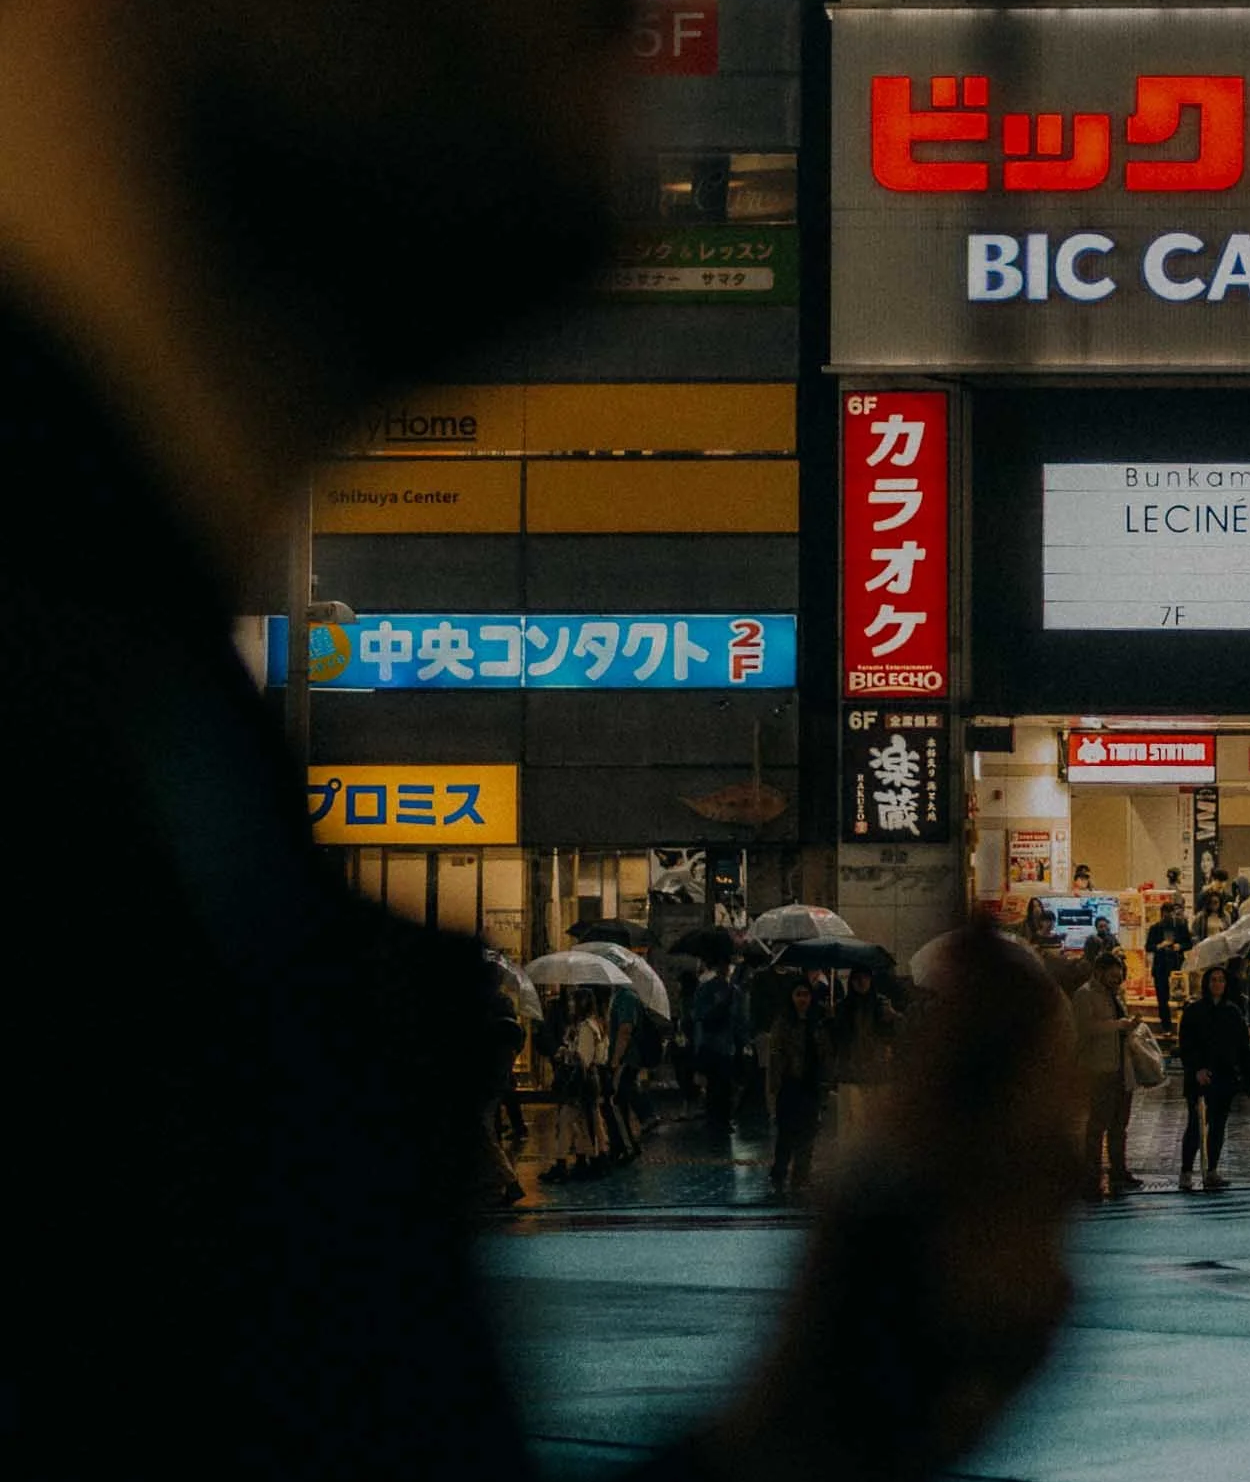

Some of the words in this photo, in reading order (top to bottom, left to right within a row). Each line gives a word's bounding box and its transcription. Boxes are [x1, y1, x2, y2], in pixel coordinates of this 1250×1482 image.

[966, 231, 1116, 302] BIC
[846, 396, 878, 416] 6F
[403, 490, 461, 505] Center
[864, 414, 927, 659] カラオケ
[1160, 606, 1186, 627] 7F
[359, 621, 709, 682] 中央コンタクト
[727, 618, 767, 683] 2F
[849, 672, 886, 691] BIG
[888, 670, 943, 691] ECHO
[848, 710, 879, 731] 6F
[306, 777, 486, 826] プロミス
